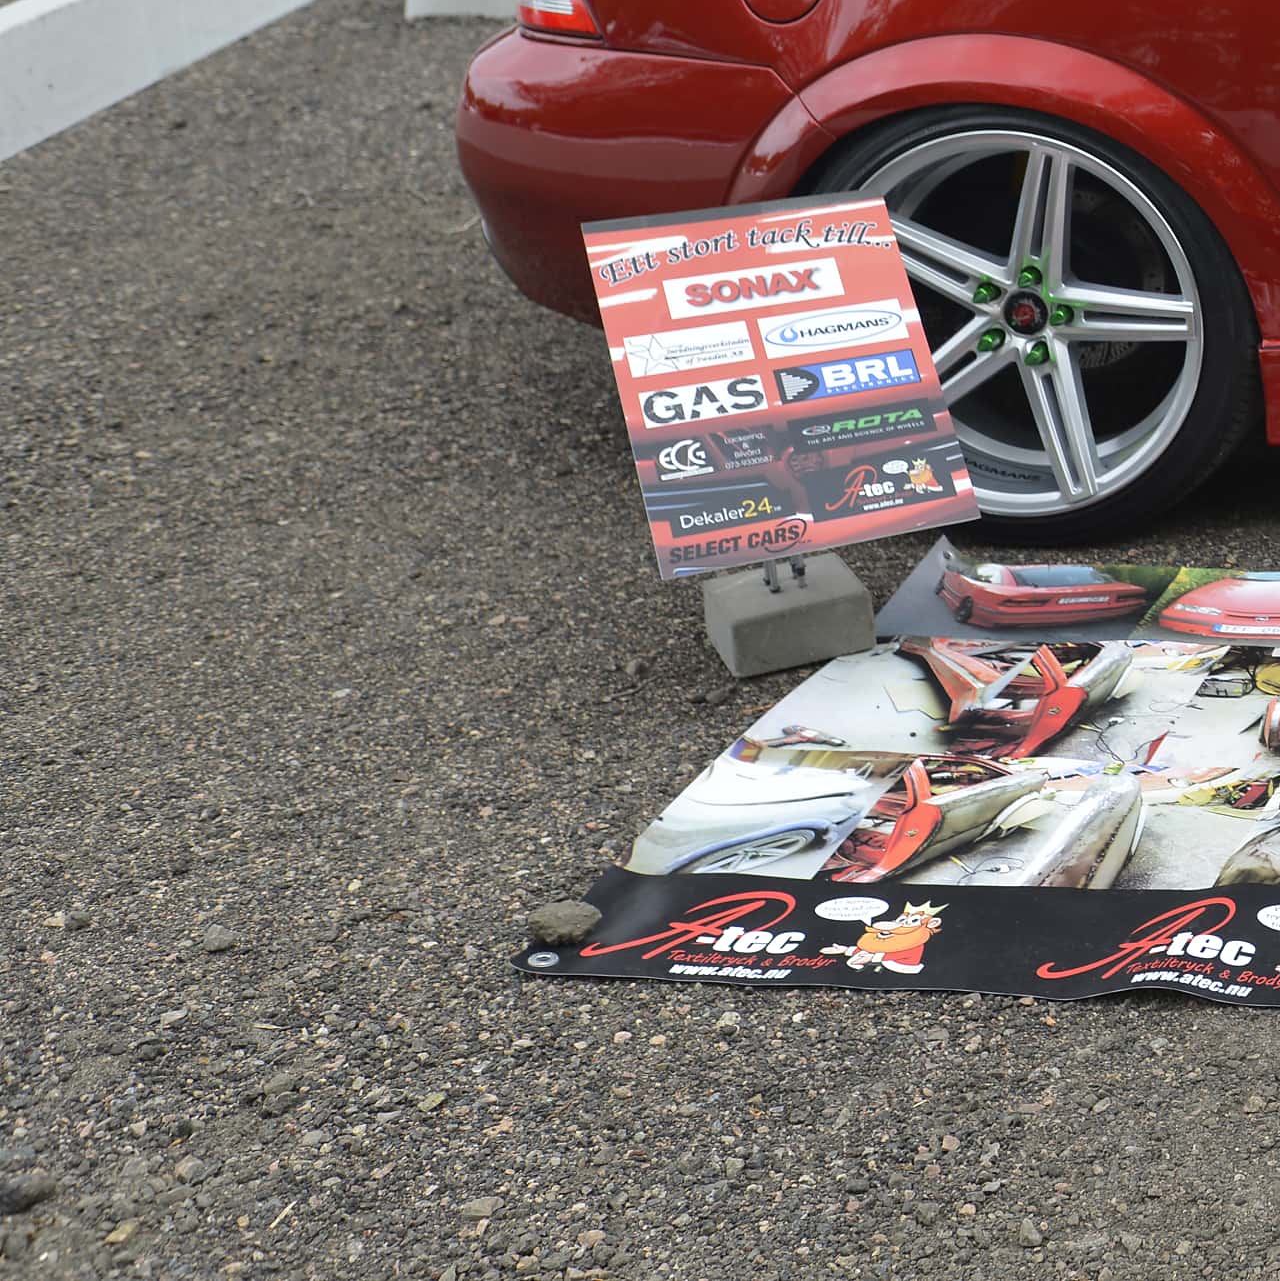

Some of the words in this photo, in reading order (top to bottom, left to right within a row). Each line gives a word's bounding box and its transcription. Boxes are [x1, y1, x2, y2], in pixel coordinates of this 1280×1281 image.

[599, 251, 659, 286] Ett
[667, 230, 739, 264] stort
[747, 219, 821, 248] tack
[685, 267, 820, 307] SONAX
[800, 317, 889, 338] HAGMANS
[821, 356, 913, 388] BRL
[643, 378, 764, 425] GAS
[832, 408, 923, 432] ROTA
[807, 438, 819, 446] THE
[670, 535, 743, 564] SELECT
[747, 524, 800, 549] CARS
[667, 949, 757, 968] Textiltryck
[760, 956, 771, 967] &
[778, 955, 837, 970] Brodyr
[667, 962, 793, 980] www.atec.nu
[1125, 955, 1215, 978] Textiltryck
[1219, 969, 1230, 980] &
[1130, 970, 1253, 999] www.atec.nu
